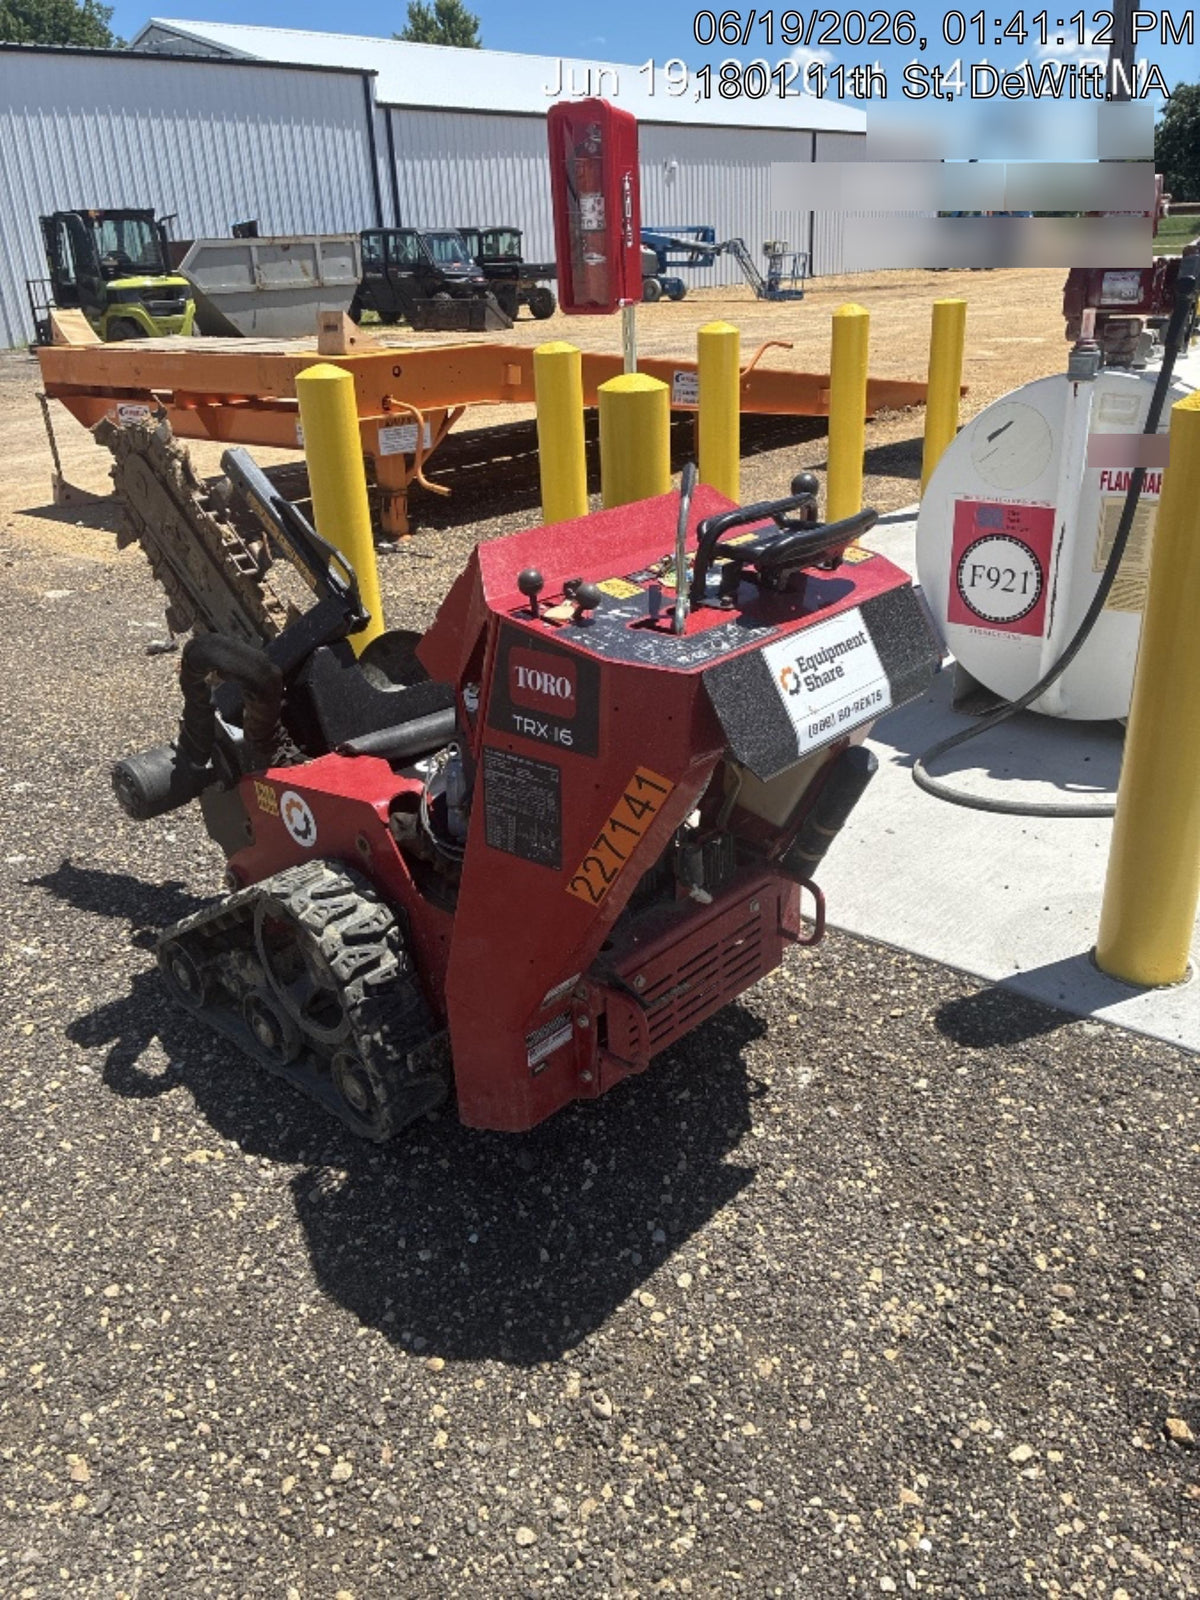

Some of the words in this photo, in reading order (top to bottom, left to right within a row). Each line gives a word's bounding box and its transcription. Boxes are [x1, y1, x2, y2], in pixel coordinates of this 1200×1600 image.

[969, 564, 1029, 595] F921
[795, 630, 868, 674] Equipment
[514, 665, 572, 699] TORO
[803, 665, 845, 692] Share
[570, 774, 667, 902] 227141
